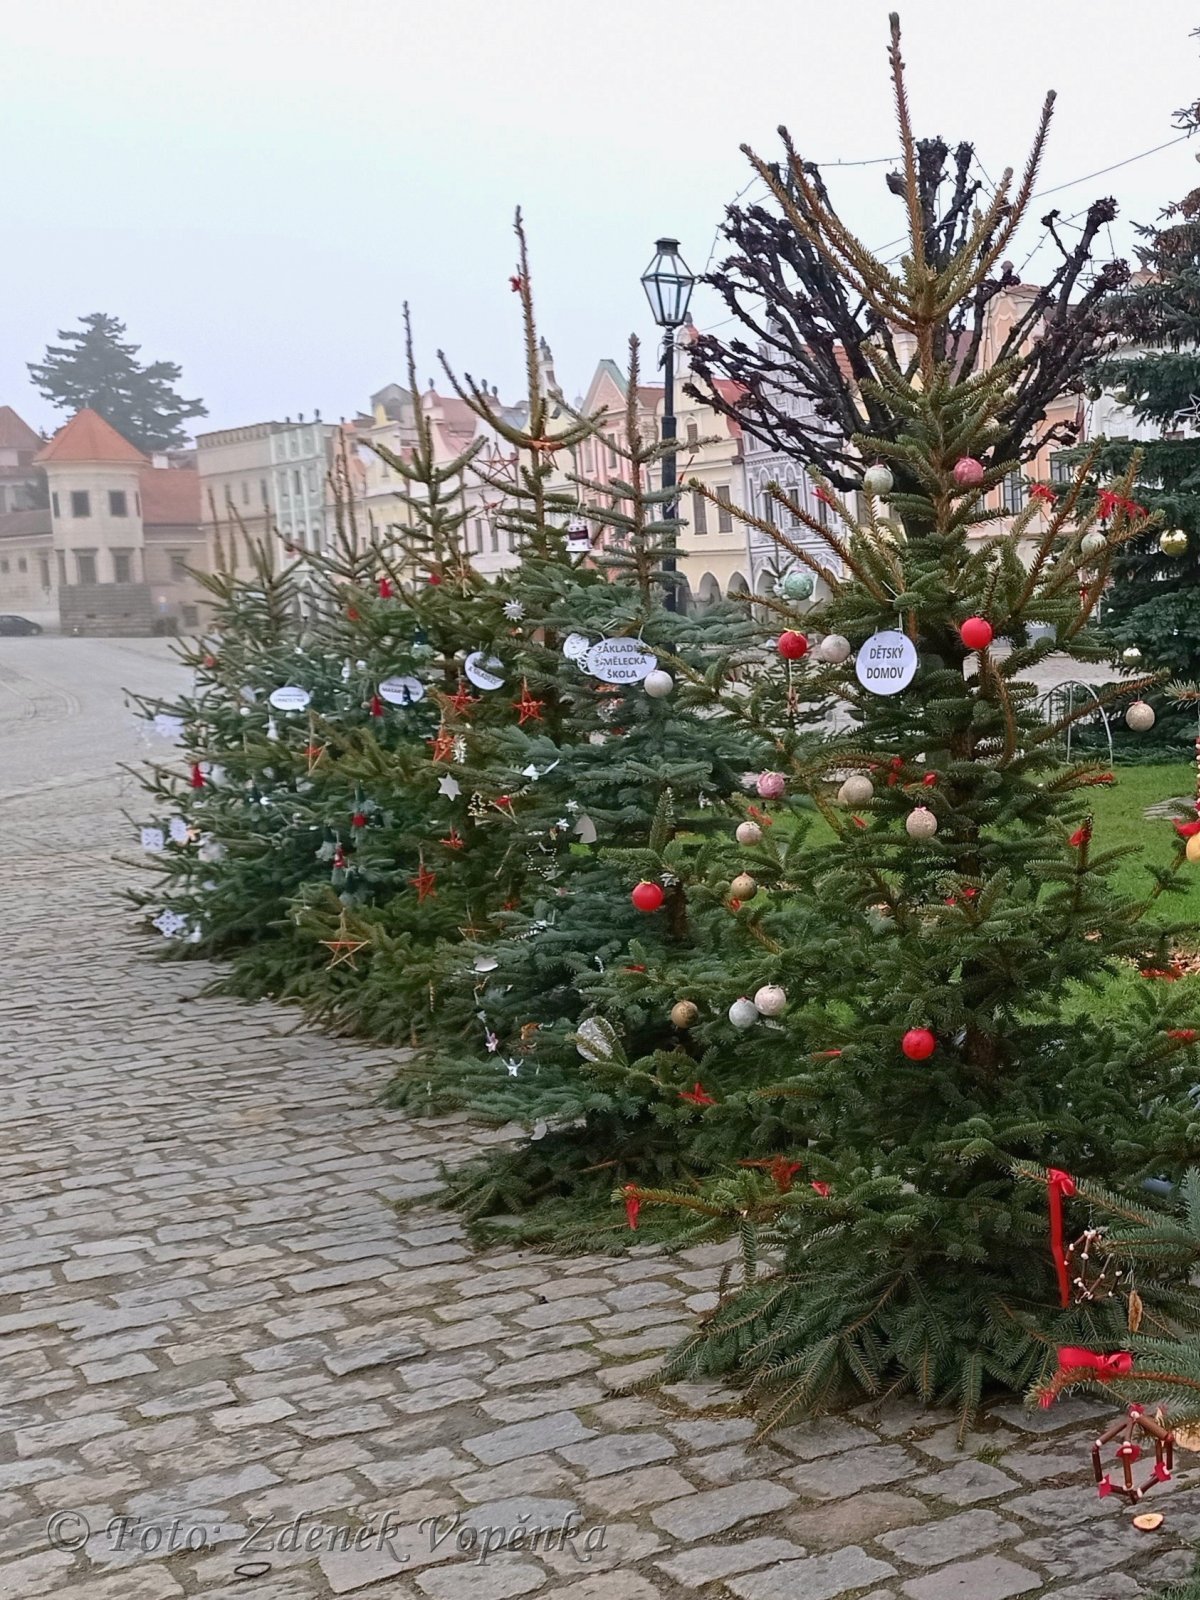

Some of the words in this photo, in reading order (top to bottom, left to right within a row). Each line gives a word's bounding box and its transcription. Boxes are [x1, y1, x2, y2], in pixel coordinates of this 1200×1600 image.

[598, 642, 641, 654] ZÁKLADN
[869, 643, 904, 660] DĚTSKÝ
[607, 669, 637, 679] ŠKOLA
[866, 667, 904, 679] DOMOV
